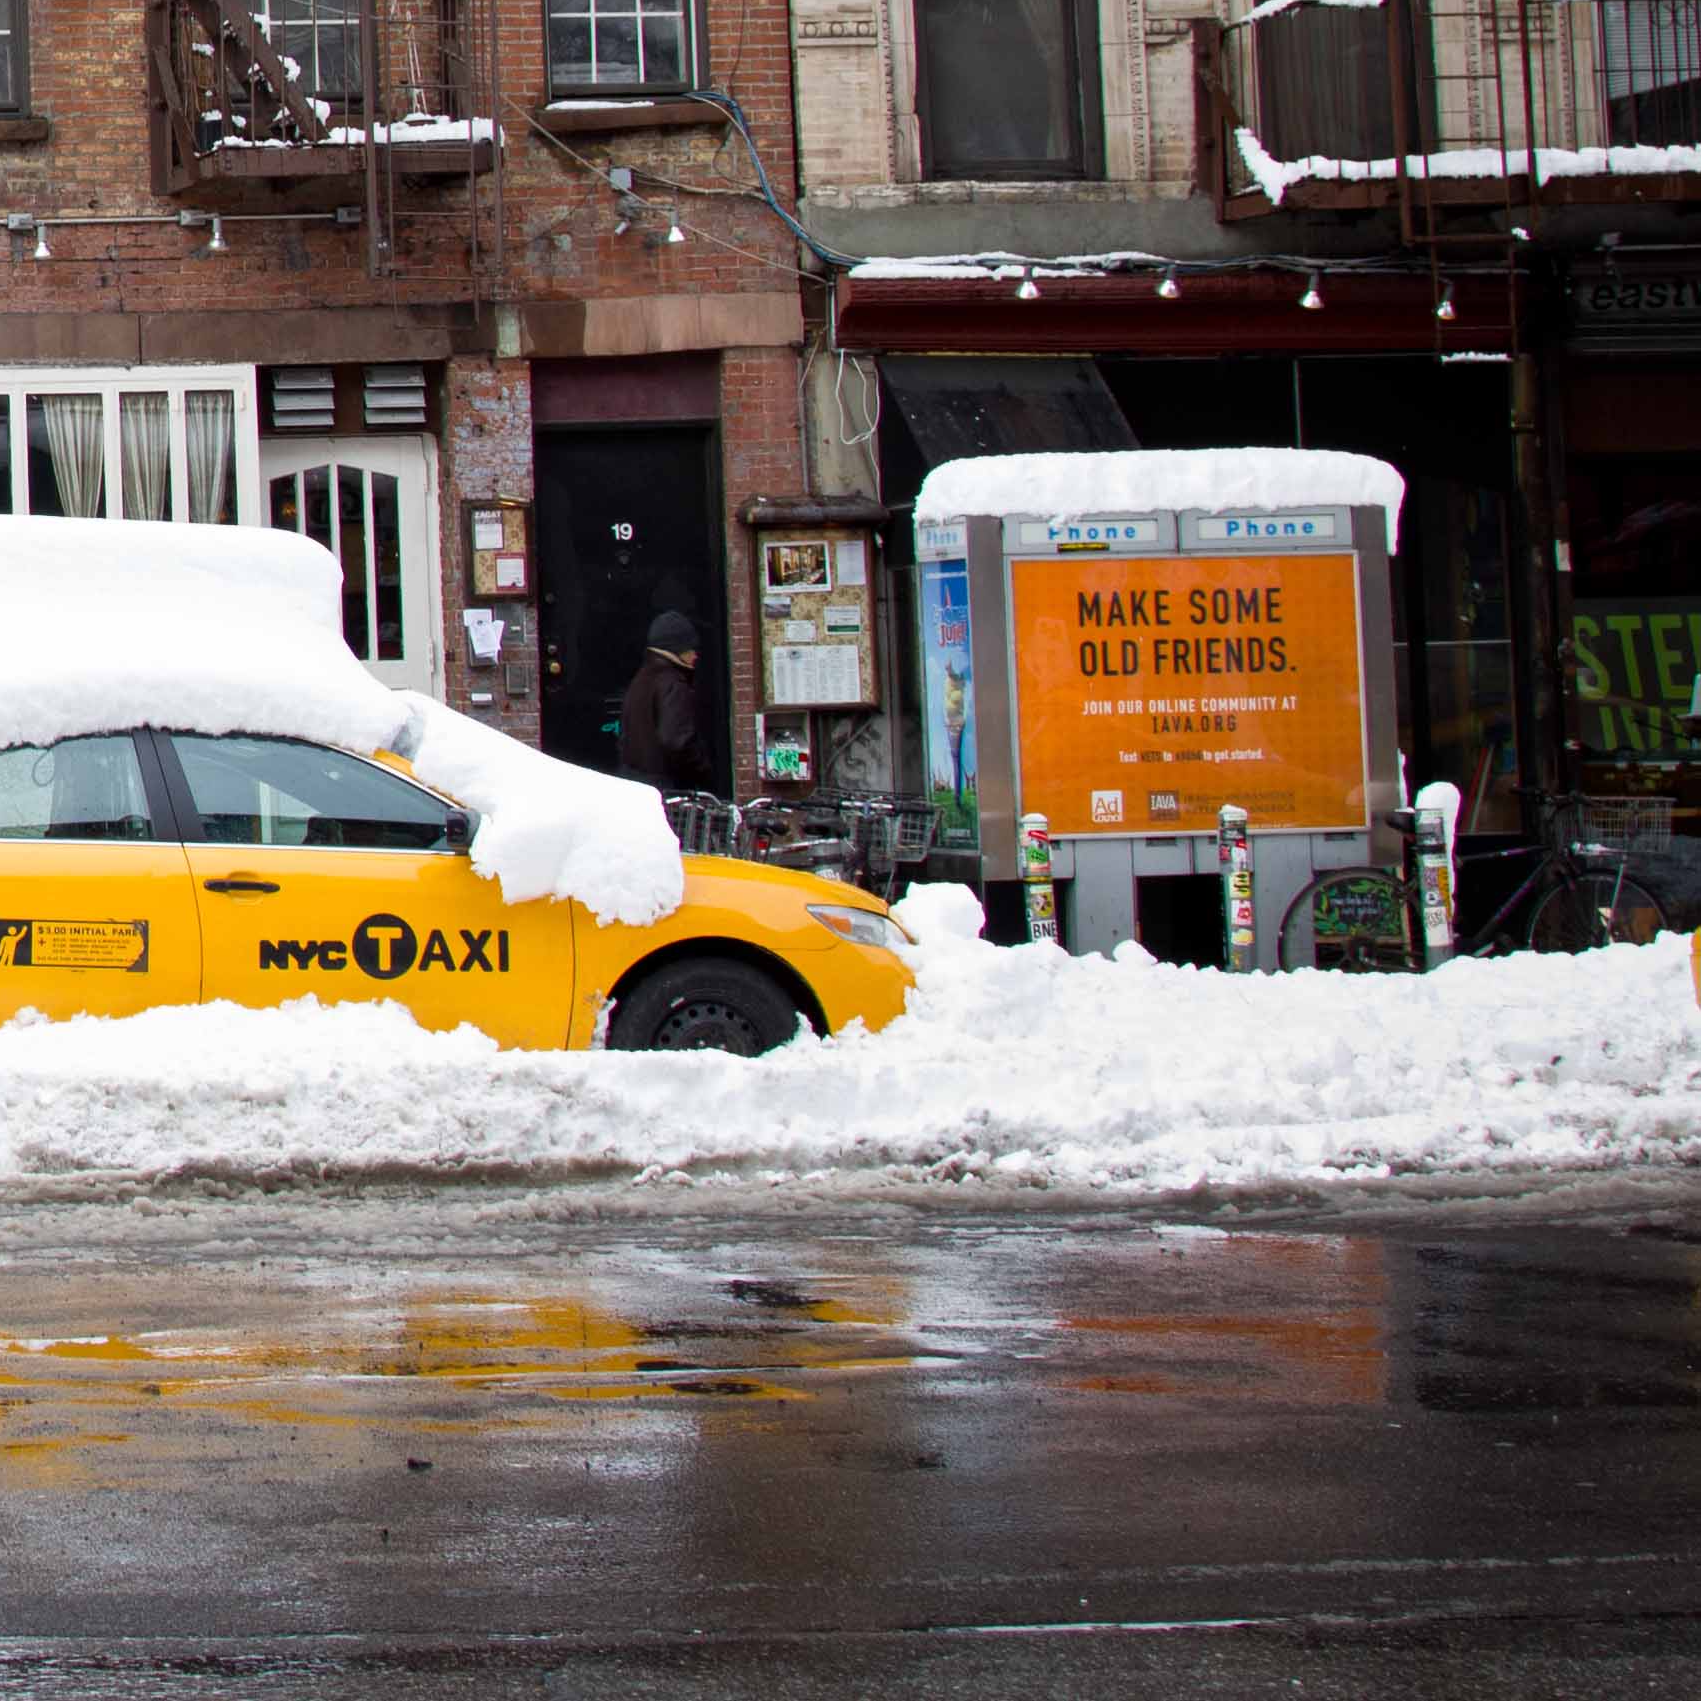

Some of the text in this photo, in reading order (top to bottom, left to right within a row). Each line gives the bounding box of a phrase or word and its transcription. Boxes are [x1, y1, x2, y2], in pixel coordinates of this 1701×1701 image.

[610, 523, 633, 541] 19
[1225, 519, 1315, 537] Phone
[1077, 587, 1283, 628] MAKE SOME
[1080, 636, 1298, 676] OLD FRIENDS.
[1082, 696, 1297, 715] JOIN OUR ONLINE COMMUNITY AT
[1152, 715, 1237, 734] IAVA.ORG
[1119, 750, 1138, 763] Text
[1163, 751, 1173, 763] to
[1203, 750, 1212, 761] to
[1094, 797, 1119, 814] Ad
[1151, 795, 1176, 810] IAVA
[69, 926, 107, 937] INITIAL
[259, 913, 510, 981] NYC TAXI
